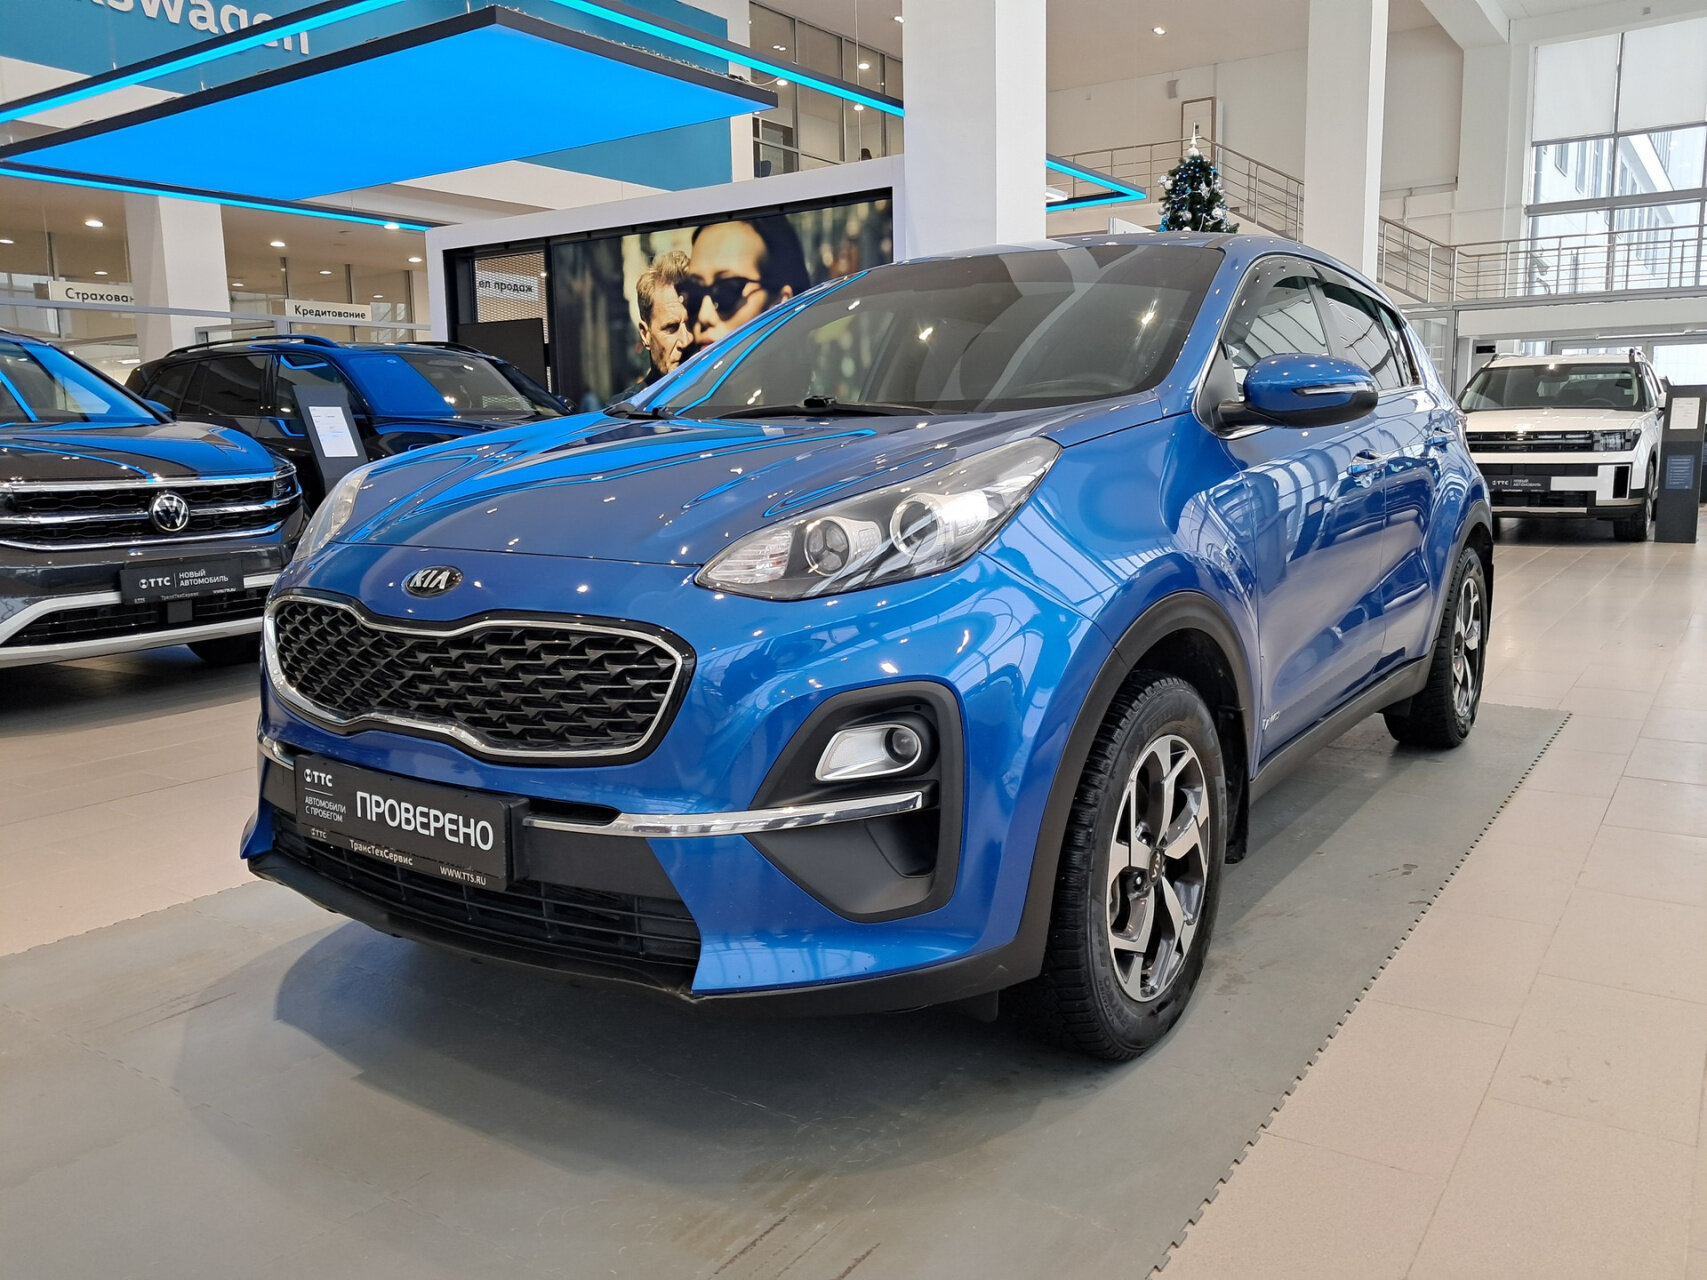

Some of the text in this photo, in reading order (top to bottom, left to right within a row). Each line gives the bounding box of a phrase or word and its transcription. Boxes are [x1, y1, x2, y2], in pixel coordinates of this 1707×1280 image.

[494, 281, 534, 293] продаж
[294, 304, 367, 319] Кредитование
[179, 568, 207, 579] НОВЫЙ
[179, 575, 229, 587] АВТОМОБИЛЬ
[409, 569, 451, 590] KIA
[312, 770, 333, 787] ТТС
[304, 795, 347, 814] АВТОМОБИЛИ
[310, 806, 343, 823] ПРОБЕГОМ
[356, 791, 494, 851] ПРОВЕРЕНО
[349, 839, 414, 866] ТрансТехСервис
[439, 865, 487, 886] WWW.TTS.RU
